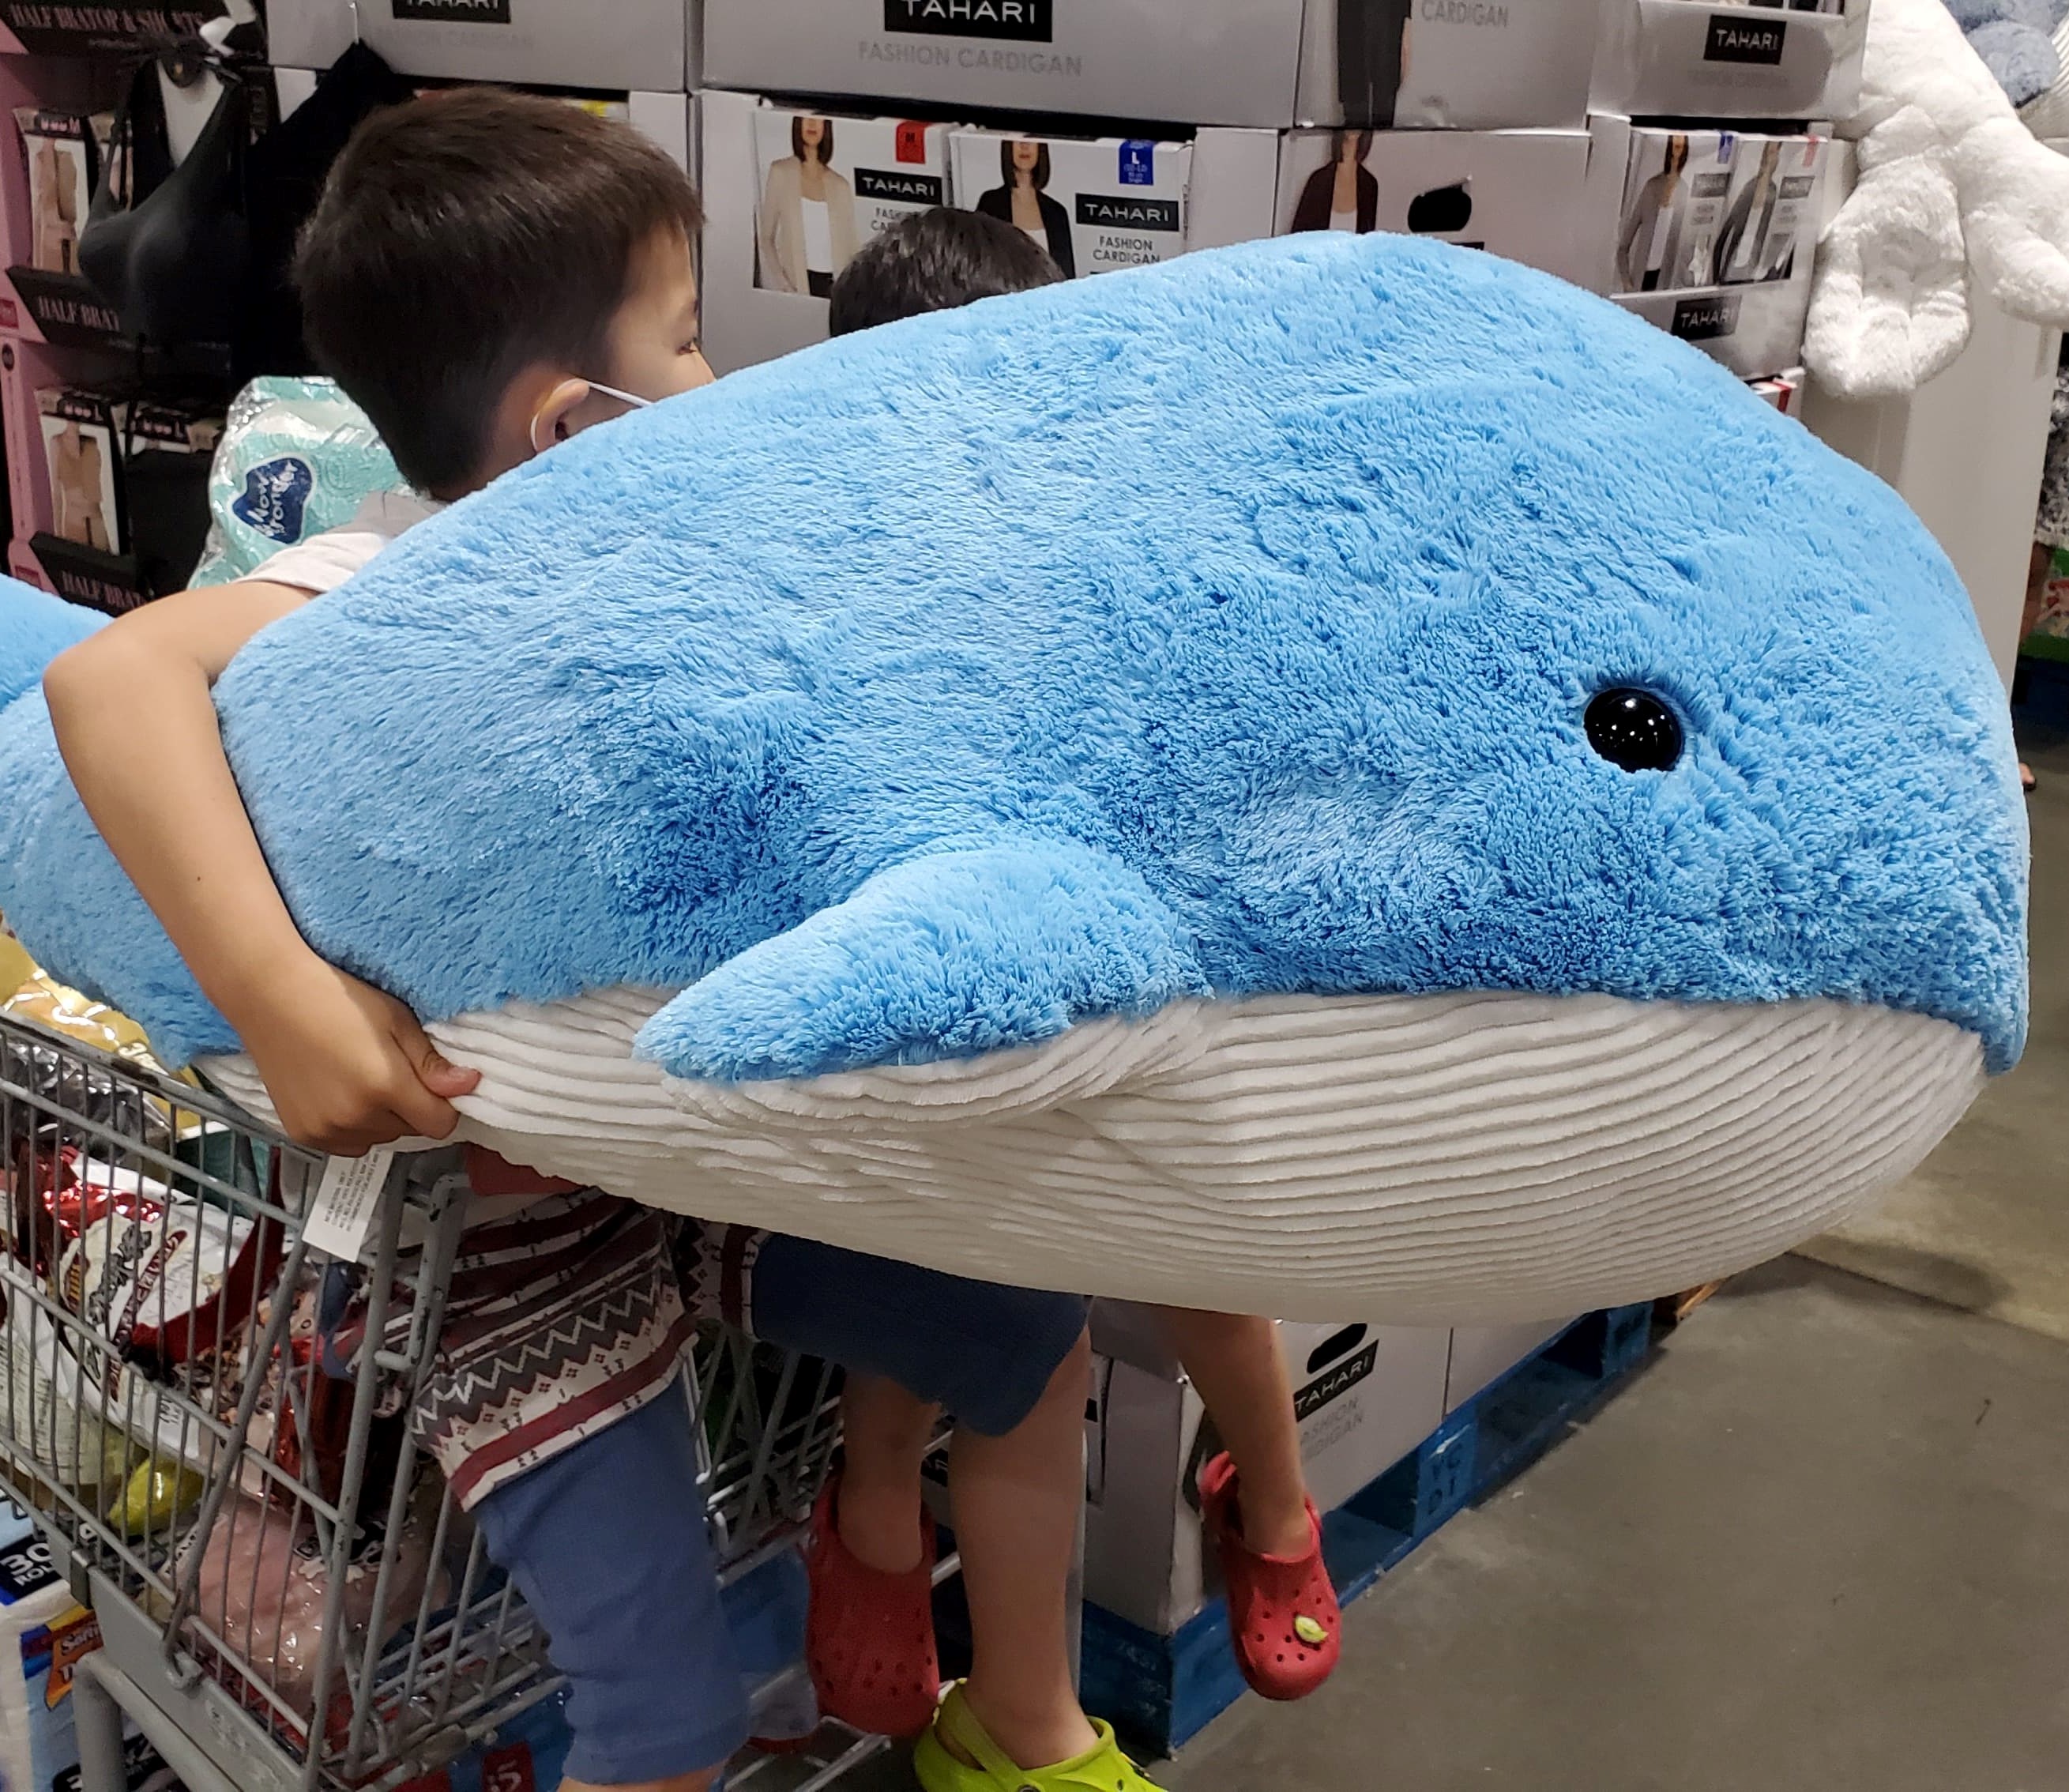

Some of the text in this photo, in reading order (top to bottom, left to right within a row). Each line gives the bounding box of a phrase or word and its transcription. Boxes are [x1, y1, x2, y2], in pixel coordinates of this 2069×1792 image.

[901, 0, 1035, 24] TAHARI
[1716, 28, 1779, 51] TAHARI
[858, 40, 1082, 77] FASHION CARDIGAN
[862, 176, 935, 197] TAHARI
[1085, 203, 1169, 222] TAHARI
[1099, 236, 1153, 251] FASHION
[1093, 250, 1160, 264] CARDIGAN
[1296, 1355, 1369, 1412] TAHARI
[1, 1542, 52, 1576] 30
